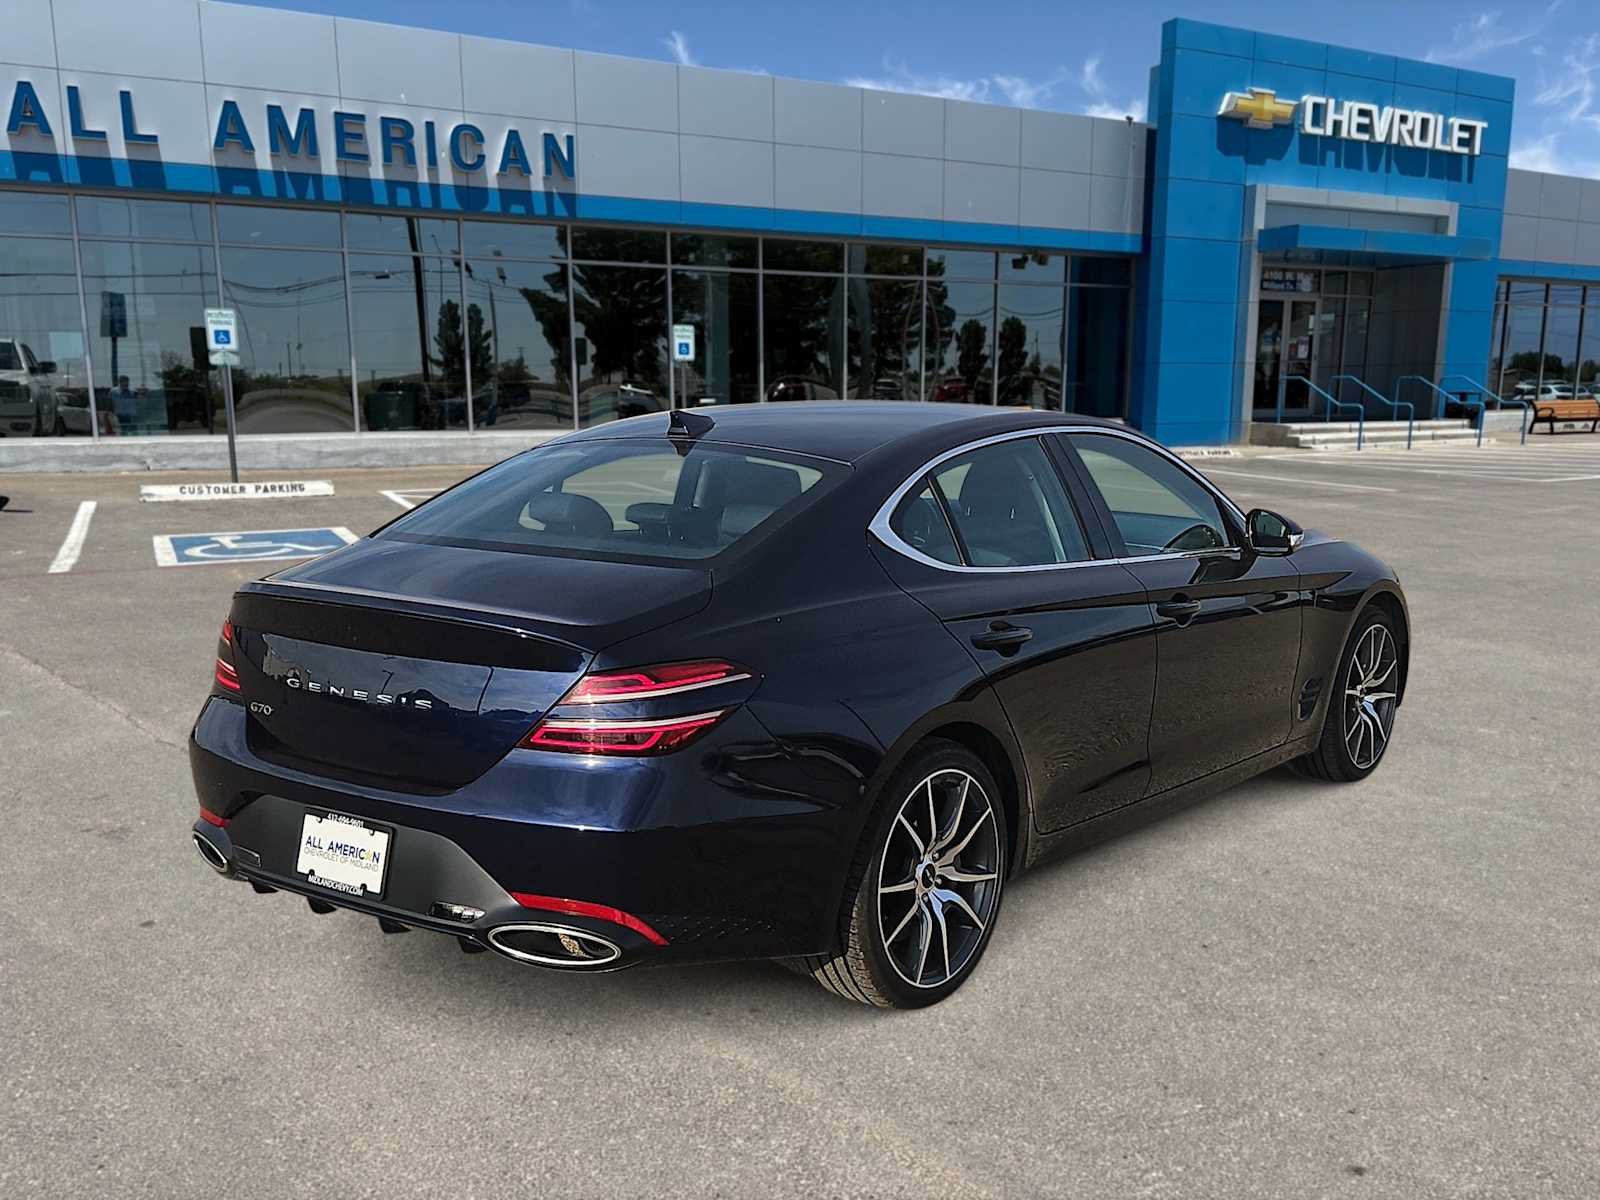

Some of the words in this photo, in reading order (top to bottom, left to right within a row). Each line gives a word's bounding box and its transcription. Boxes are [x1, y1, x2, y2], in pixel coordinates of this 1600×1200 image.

[7, 80, 158, 144] ALL
[213, 99, 576, 181] AMERICAN
[1302, 94, 1488, 156] CHEVROLET
[179, 485, 246, 496] CUSTOMER
[254, 483, 306, 494] PARKING
[250, 701, 273, 716] G70
[286, 678, 432, 710] GENESIS
[303, 846, 339, 862] CHEVROLET
[339, 854, 349, 864] OF
[350, 858, 379, 873] MIDLAND
[305, 835, 323, 850] ALL
[327, 840, 381, 864] AMERICN
